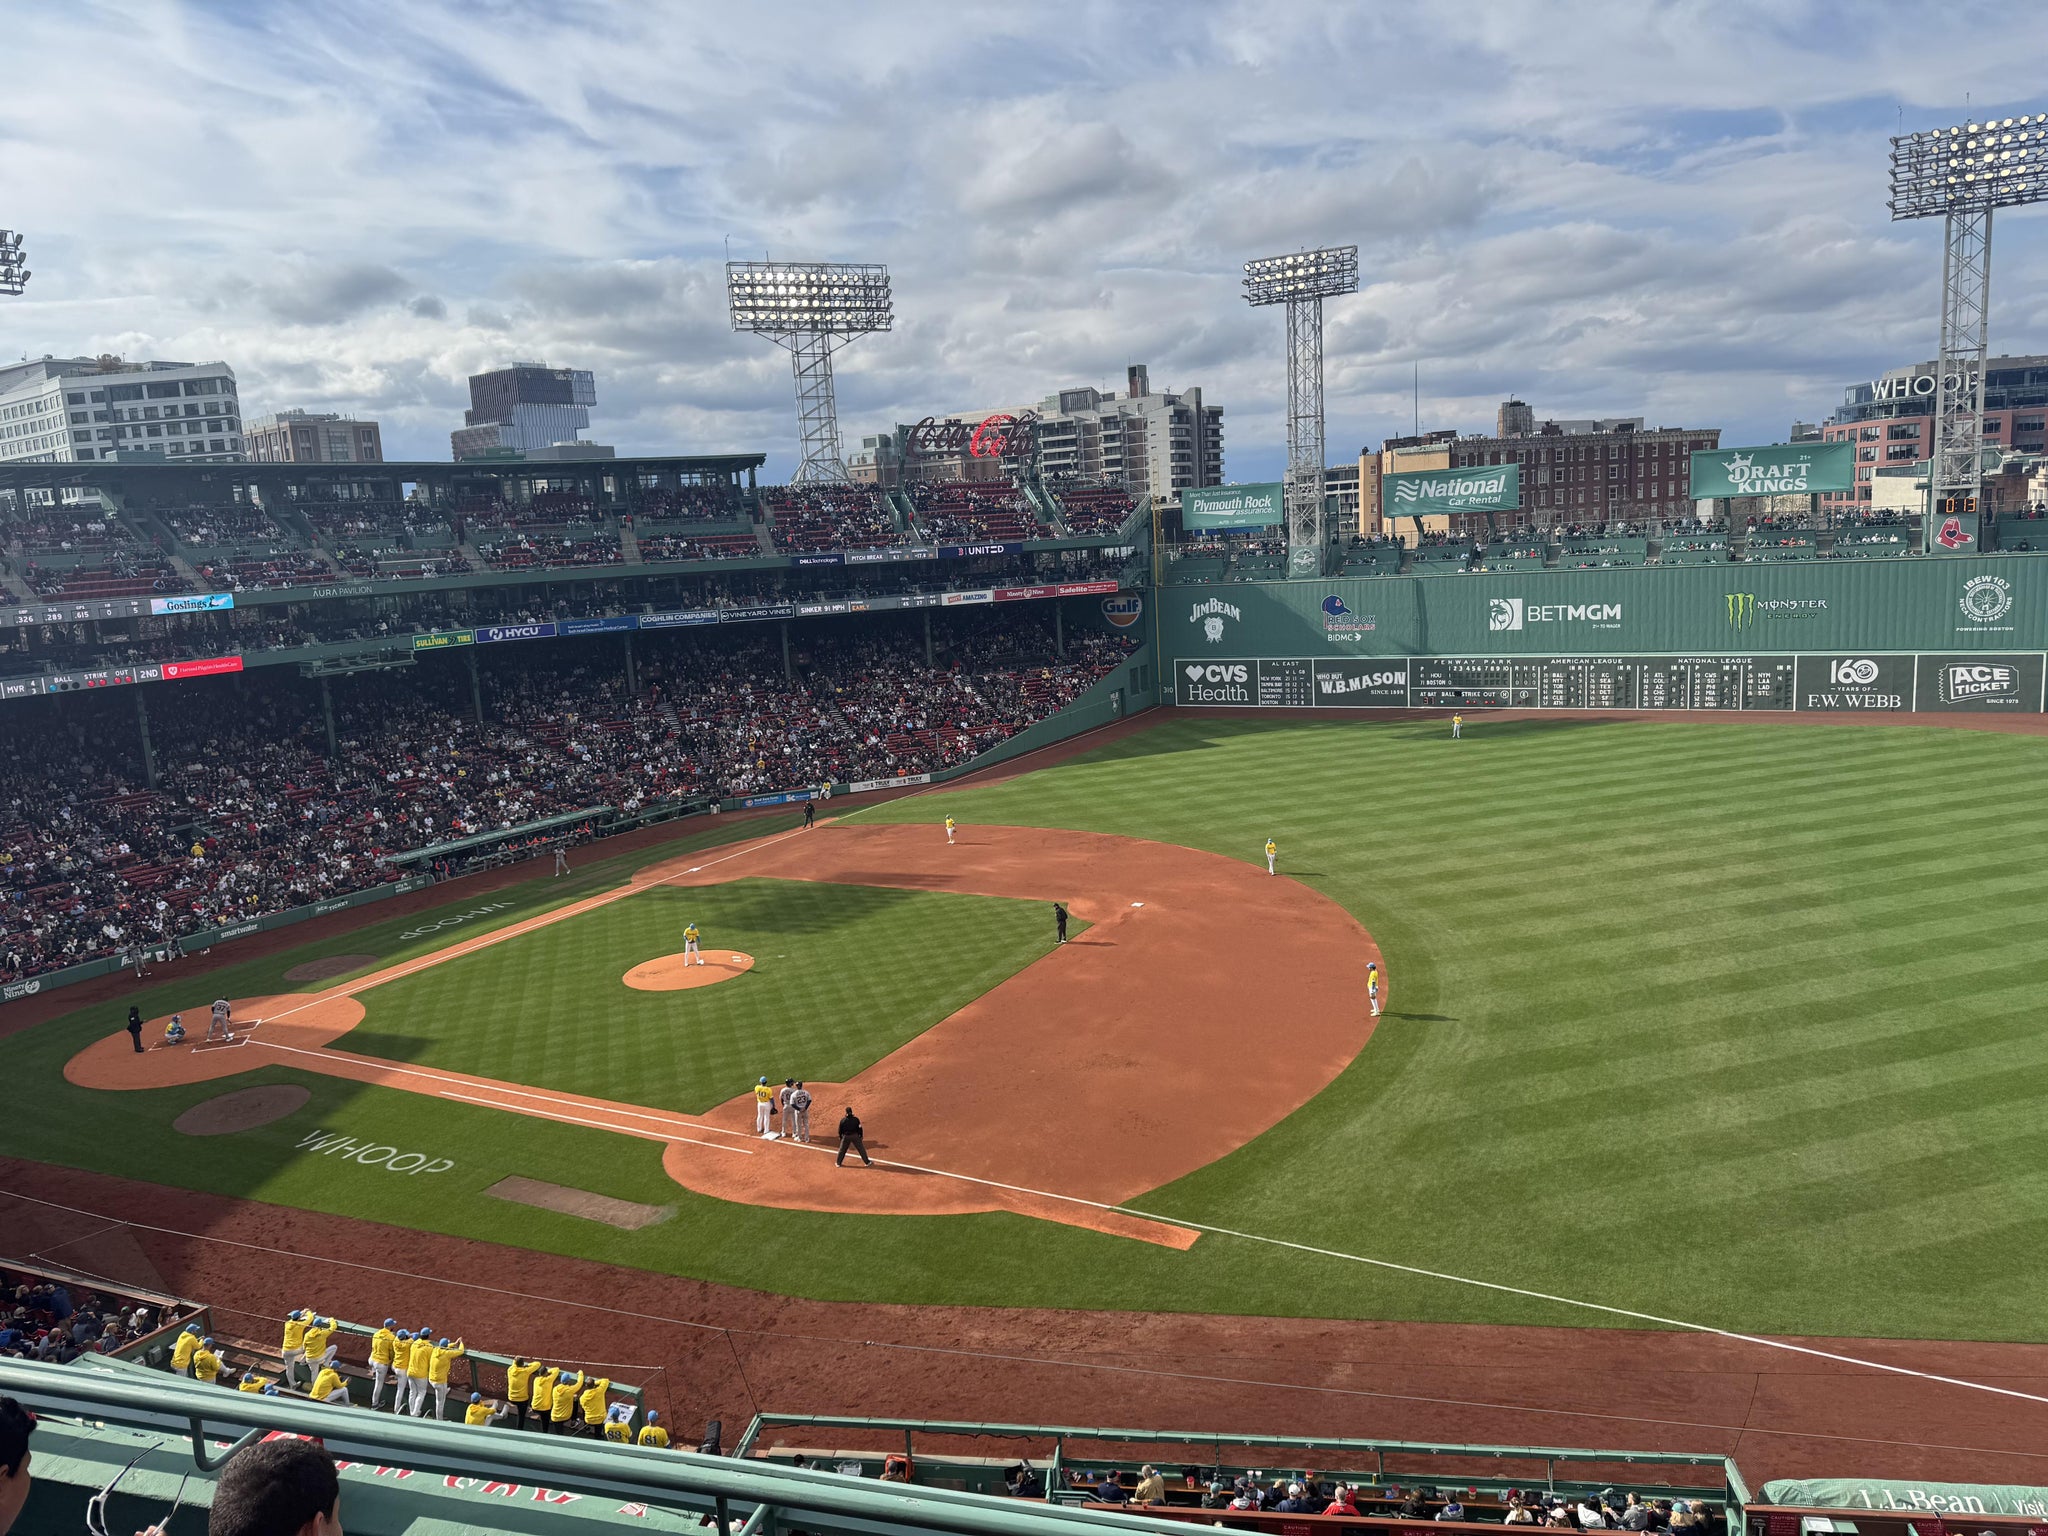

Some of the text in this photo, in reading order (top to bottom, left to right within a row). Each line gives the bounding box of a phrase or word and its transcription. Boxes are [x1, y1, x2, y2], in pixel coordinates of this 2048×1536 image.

[1728, 463, 1811, 483] DRAFT
[1420, 475, 1506, 498] National
[1738, 478, 1808, 494] KINGS
[1193, 494, 1272, 512] Plymouth Rock
[1448, 495, 1502, 506] Car Rental
[968, 546, 1004, 555] UNITED
[1963, 576, 2010, 590] IBEW 103
[313, 586, 373, 598] AURA PAVILION
[166, 600, 207, 611] Goslings
[1102, 600, 1140, 613] Gulf
[1757, 599, 1828, 610] MONSTER
[16, 616, 34, 624] .326
[45, 613, 62, 622] .289
[641, 614, 674, 623] COGHLIN
[674, 612, 717, 621] COMPANIES
[1328, 614, 1376, 624] RED SOX
[1528, 604, 1622, 621] BETMGM
[506, 627, 538, 638] HYCU
[416, 634, 471, 648] SULLIVAN TIRE
[84, 672, 108, 680] STRIKE
[140, 670, 158, 678] 2ND
[1205, 665, 1248, 682] CVS
[1831, 659, 1879, 684] 160
[1955, 666, 2010, 684] ACE
[7, 685, 24, 694] MVR
[1188, 684, 1248, 701] Health
[1955, 682, 2010, 695] TICKET
[1808, 694, 1901, 707] F.W. WEBB
[328, 901, 348, 911] TICKET
[220, 924, 258, 938] smartwater
[3, 984, 25, 994] Ninety
[5, 990, 25, 999] Nine
[295, 1130, 454, 1175] WHOOP
[645, 1435, 657, 1444] 81
[2012, 1499, 2046, 1516] Visit
